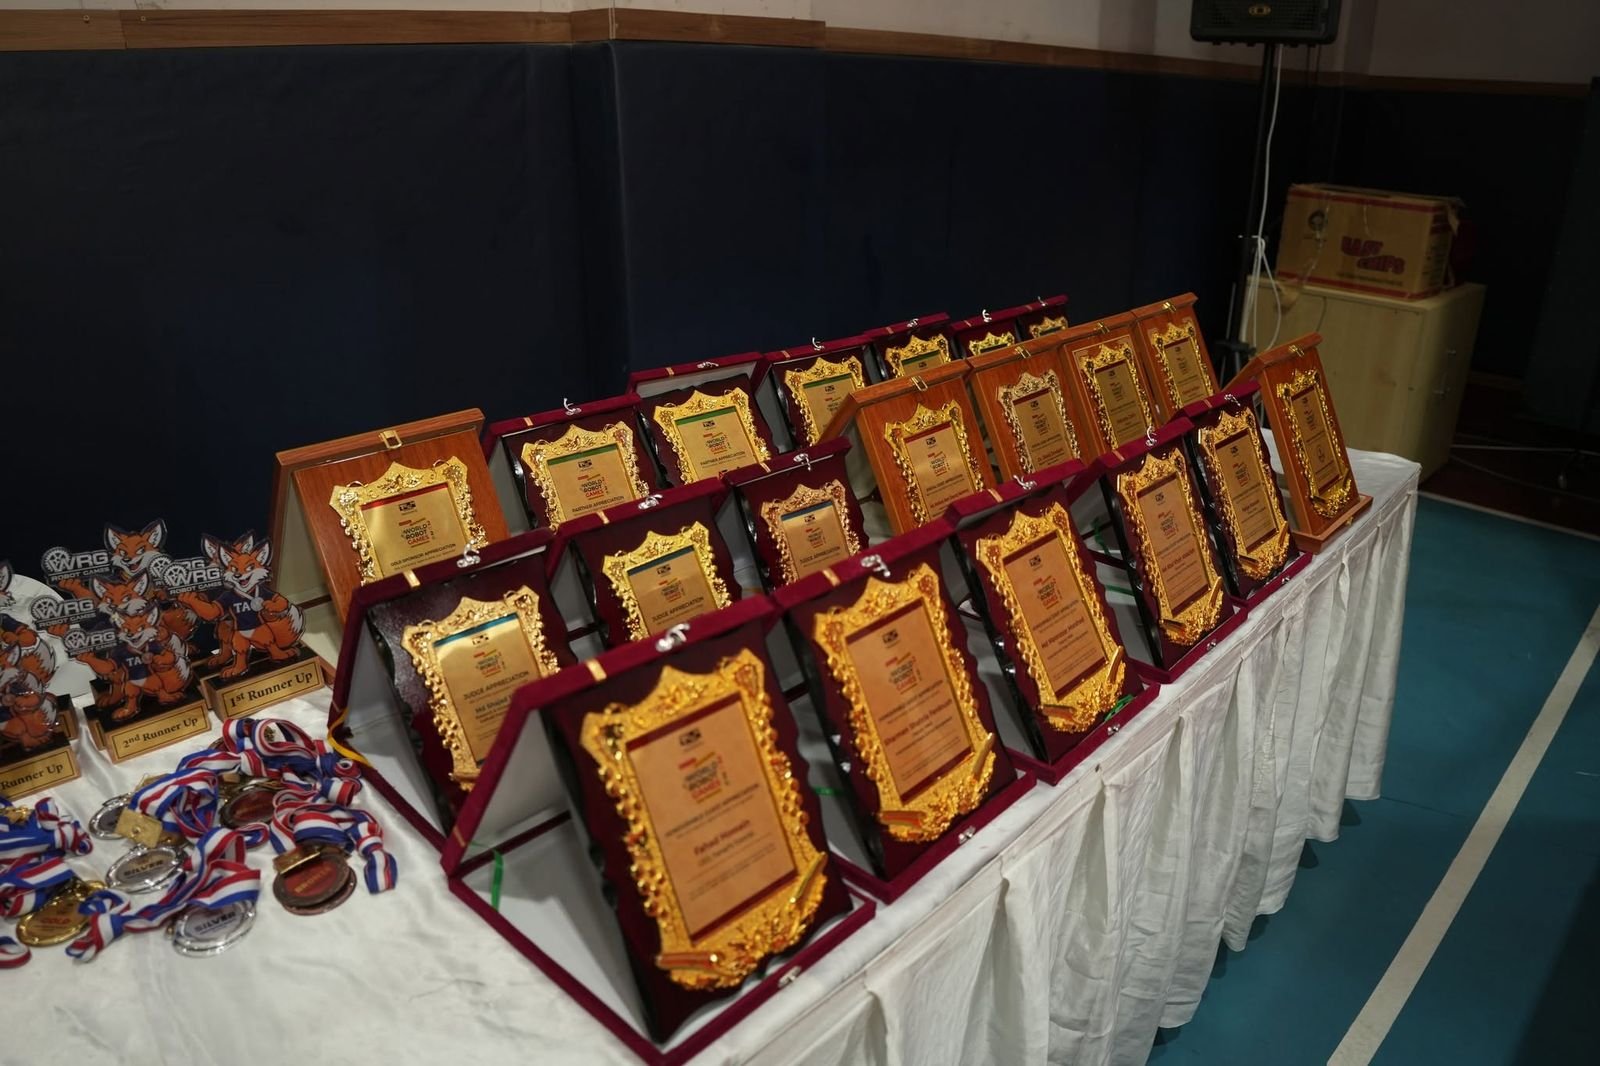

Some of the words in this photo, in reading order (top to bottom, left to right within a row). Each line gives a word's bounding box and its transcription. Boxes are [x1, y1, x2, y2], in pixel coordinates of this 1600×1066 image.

[582, 479, 602, 488] WORLD
[583, 484, 602, 492] ROBOT
[572, 503, 592, 512] PARTNER
[593, 495, 624, 508] APPRECIATION
[403, 524, 428, 535] WORLD
[405, 530, 427, 540] ROBOT
[407, 535, 430, 545] GAMES
[424, 543, 456, 556] APPRECIATION
[48, 551, 109, 572] WRG
[52, 572, 80, 581] ROBOT
[83, 567, 110, 576] GAMES
[166, 568, 220, 587] WRG
[170, 586, 197, 595] ROBOT
[198, 582, 222, 590] GAMES
[36, 600, 94, 619] WRG
[39, 617, 69, 627] ROBOT
[70, 613, 96, 622] GAMES
[67, 631, 116, 649] WRG
[230, 692, 245, 708] 1st
[247, 678, 292, 701] Runner
[294, 672, 313, 684] Up
[464, 687, 485, 700] JUDGE
[486, 671, 529, 691] APPRECIATION
[123, 734, 140, 748] 2nd
[142, 723, 182, 742] Runner
[183, 718, 198, 727] Up
[0, 770, 45, 790] Runner
[46, 764, 63, 774] Up
[124, 860, 164, 876] SILVER
[194, 911, 236, 932] SILVER
